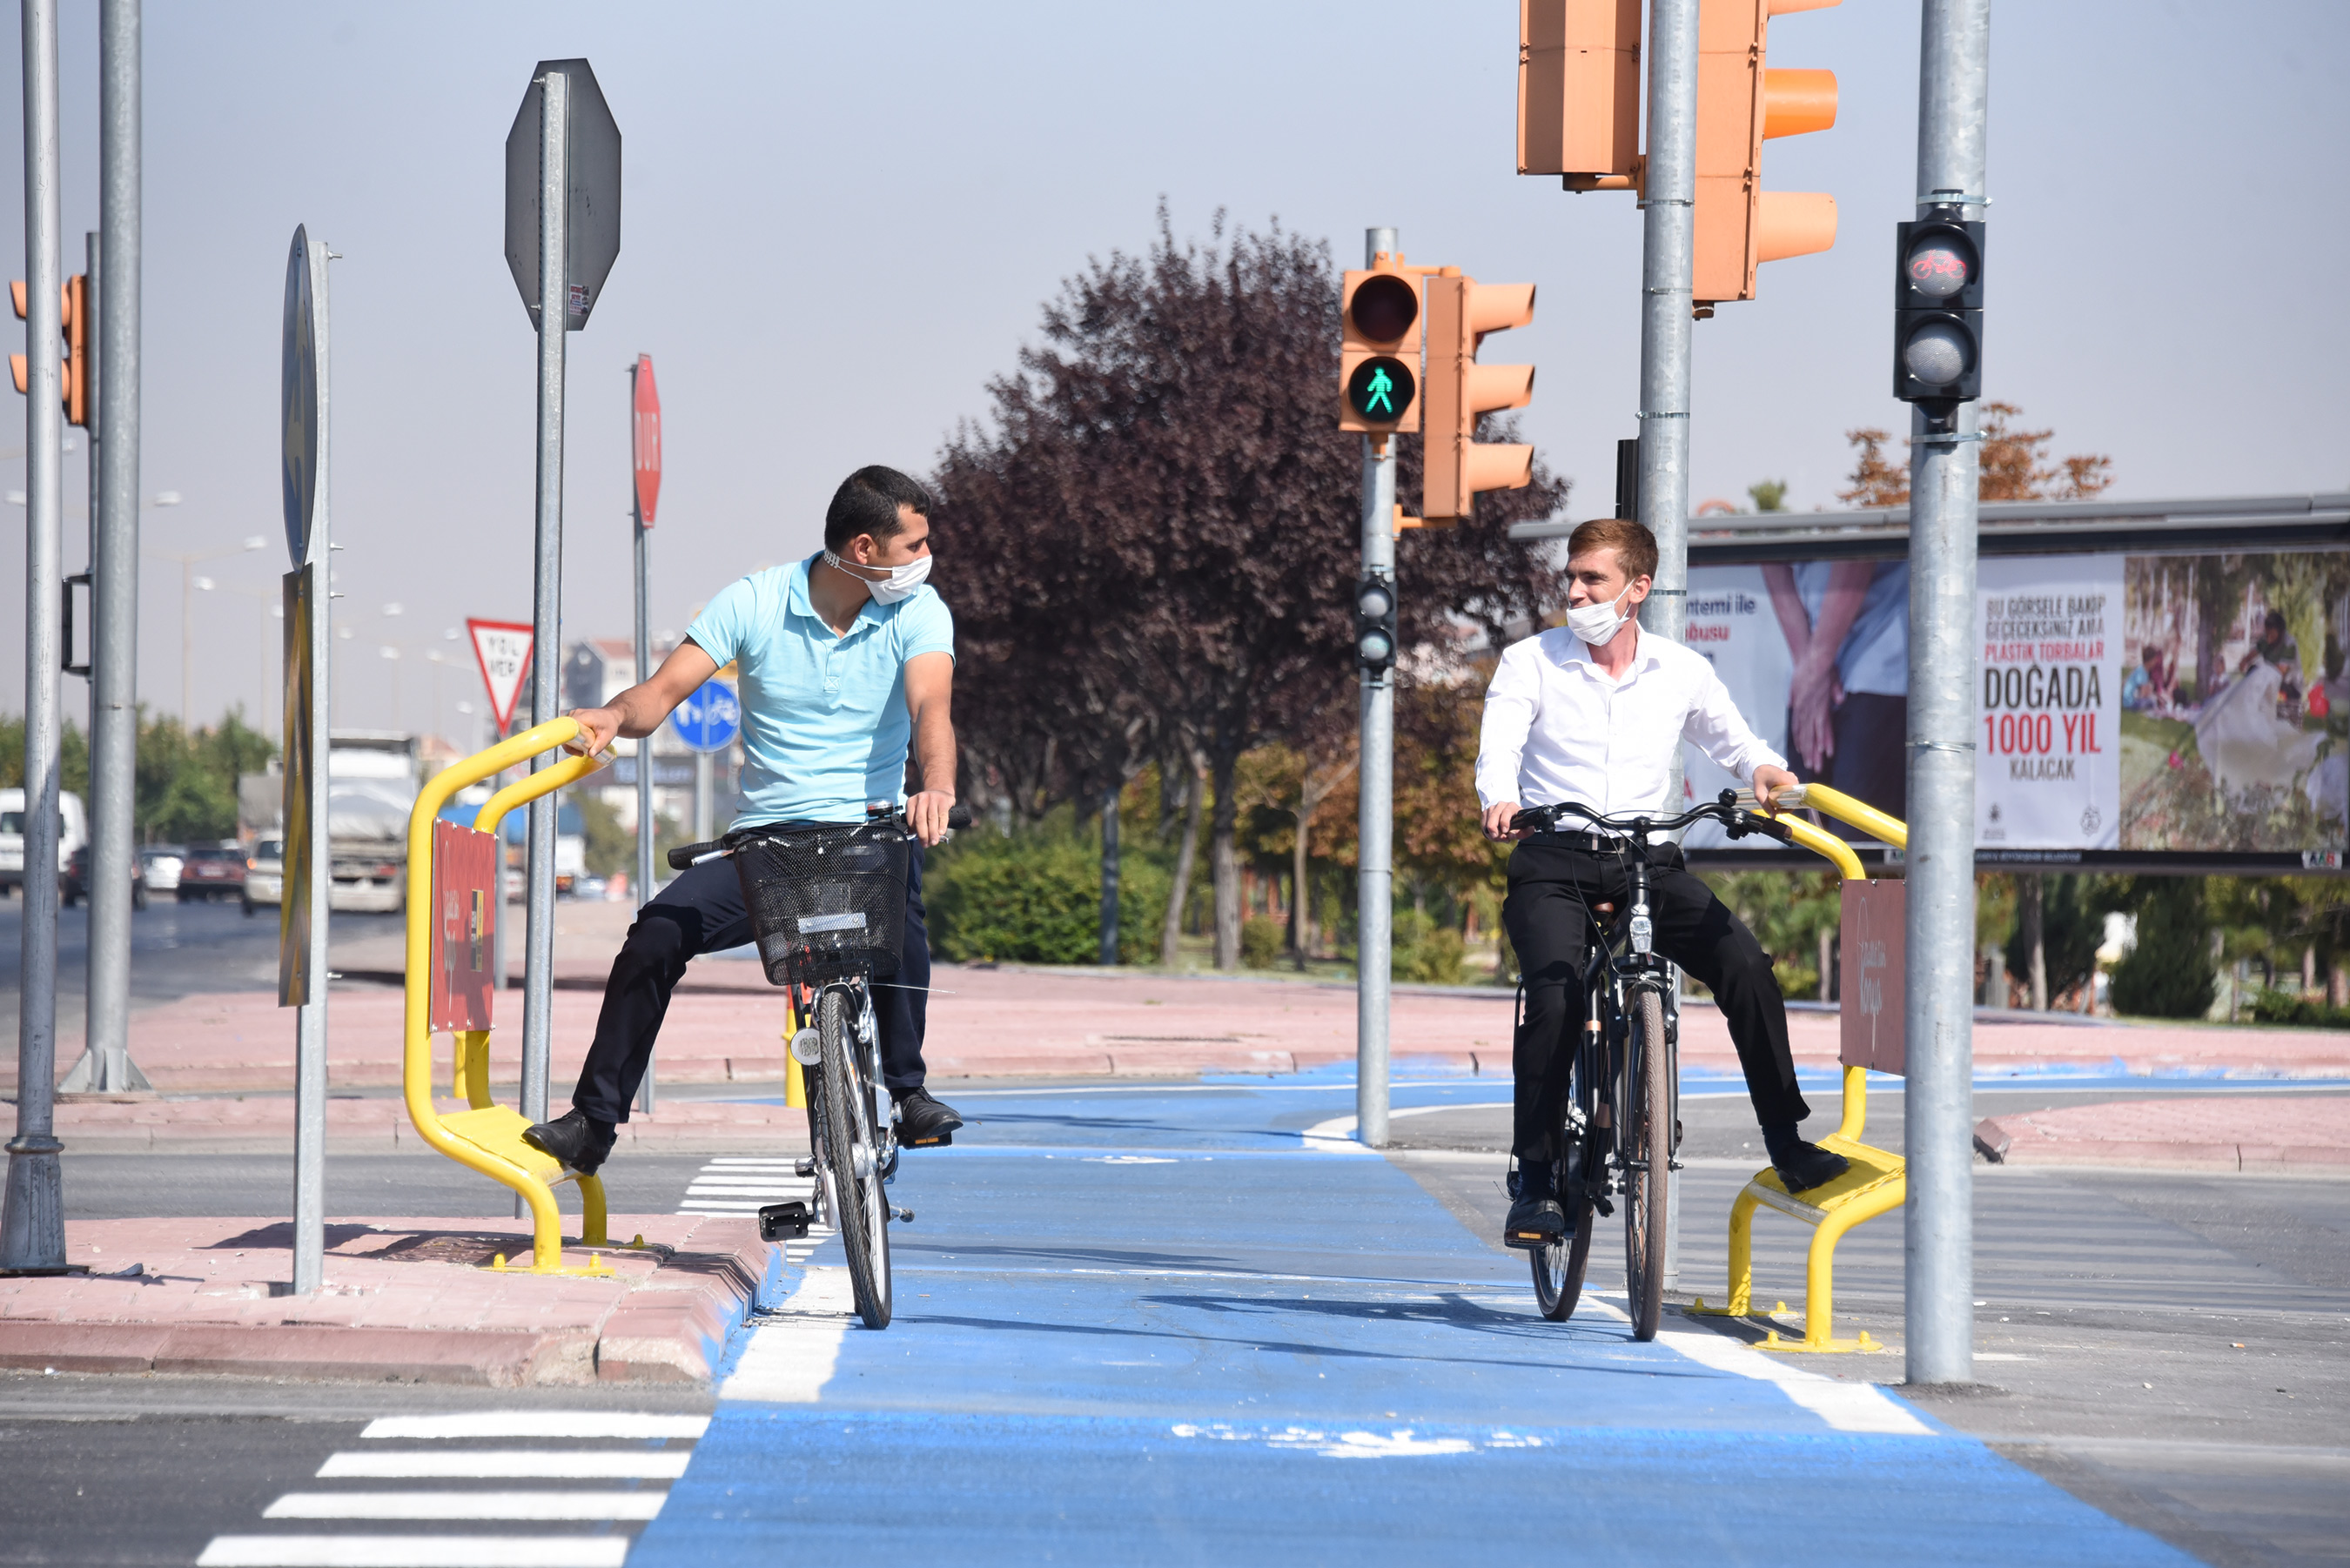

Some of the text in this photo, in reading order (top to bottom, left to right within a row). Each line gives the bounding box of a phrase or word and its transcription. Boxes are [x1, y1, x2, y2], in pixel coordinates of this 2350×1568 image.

[635, 412, 659, 472] DUR
[1686, 594, 1756, 614] ntemi ile
[1987, 598, 2004, 618] BU
[2008, 596, 2064, 618] GÖRSELE
[1686, 623, 1729, 641] busu
[2078, 618, 2105, 639] AMA
[487, 637, 520, 656] YOL
[2039, 641, 2105, 661] TORBALAR
[487, 659, 515, 676] VER
[1984, 664, 2101, 709] DOĞADA
[1984, 714, 2101, 754] 1000 YIL
[2010, 759, 2076, 781] KALACAK
